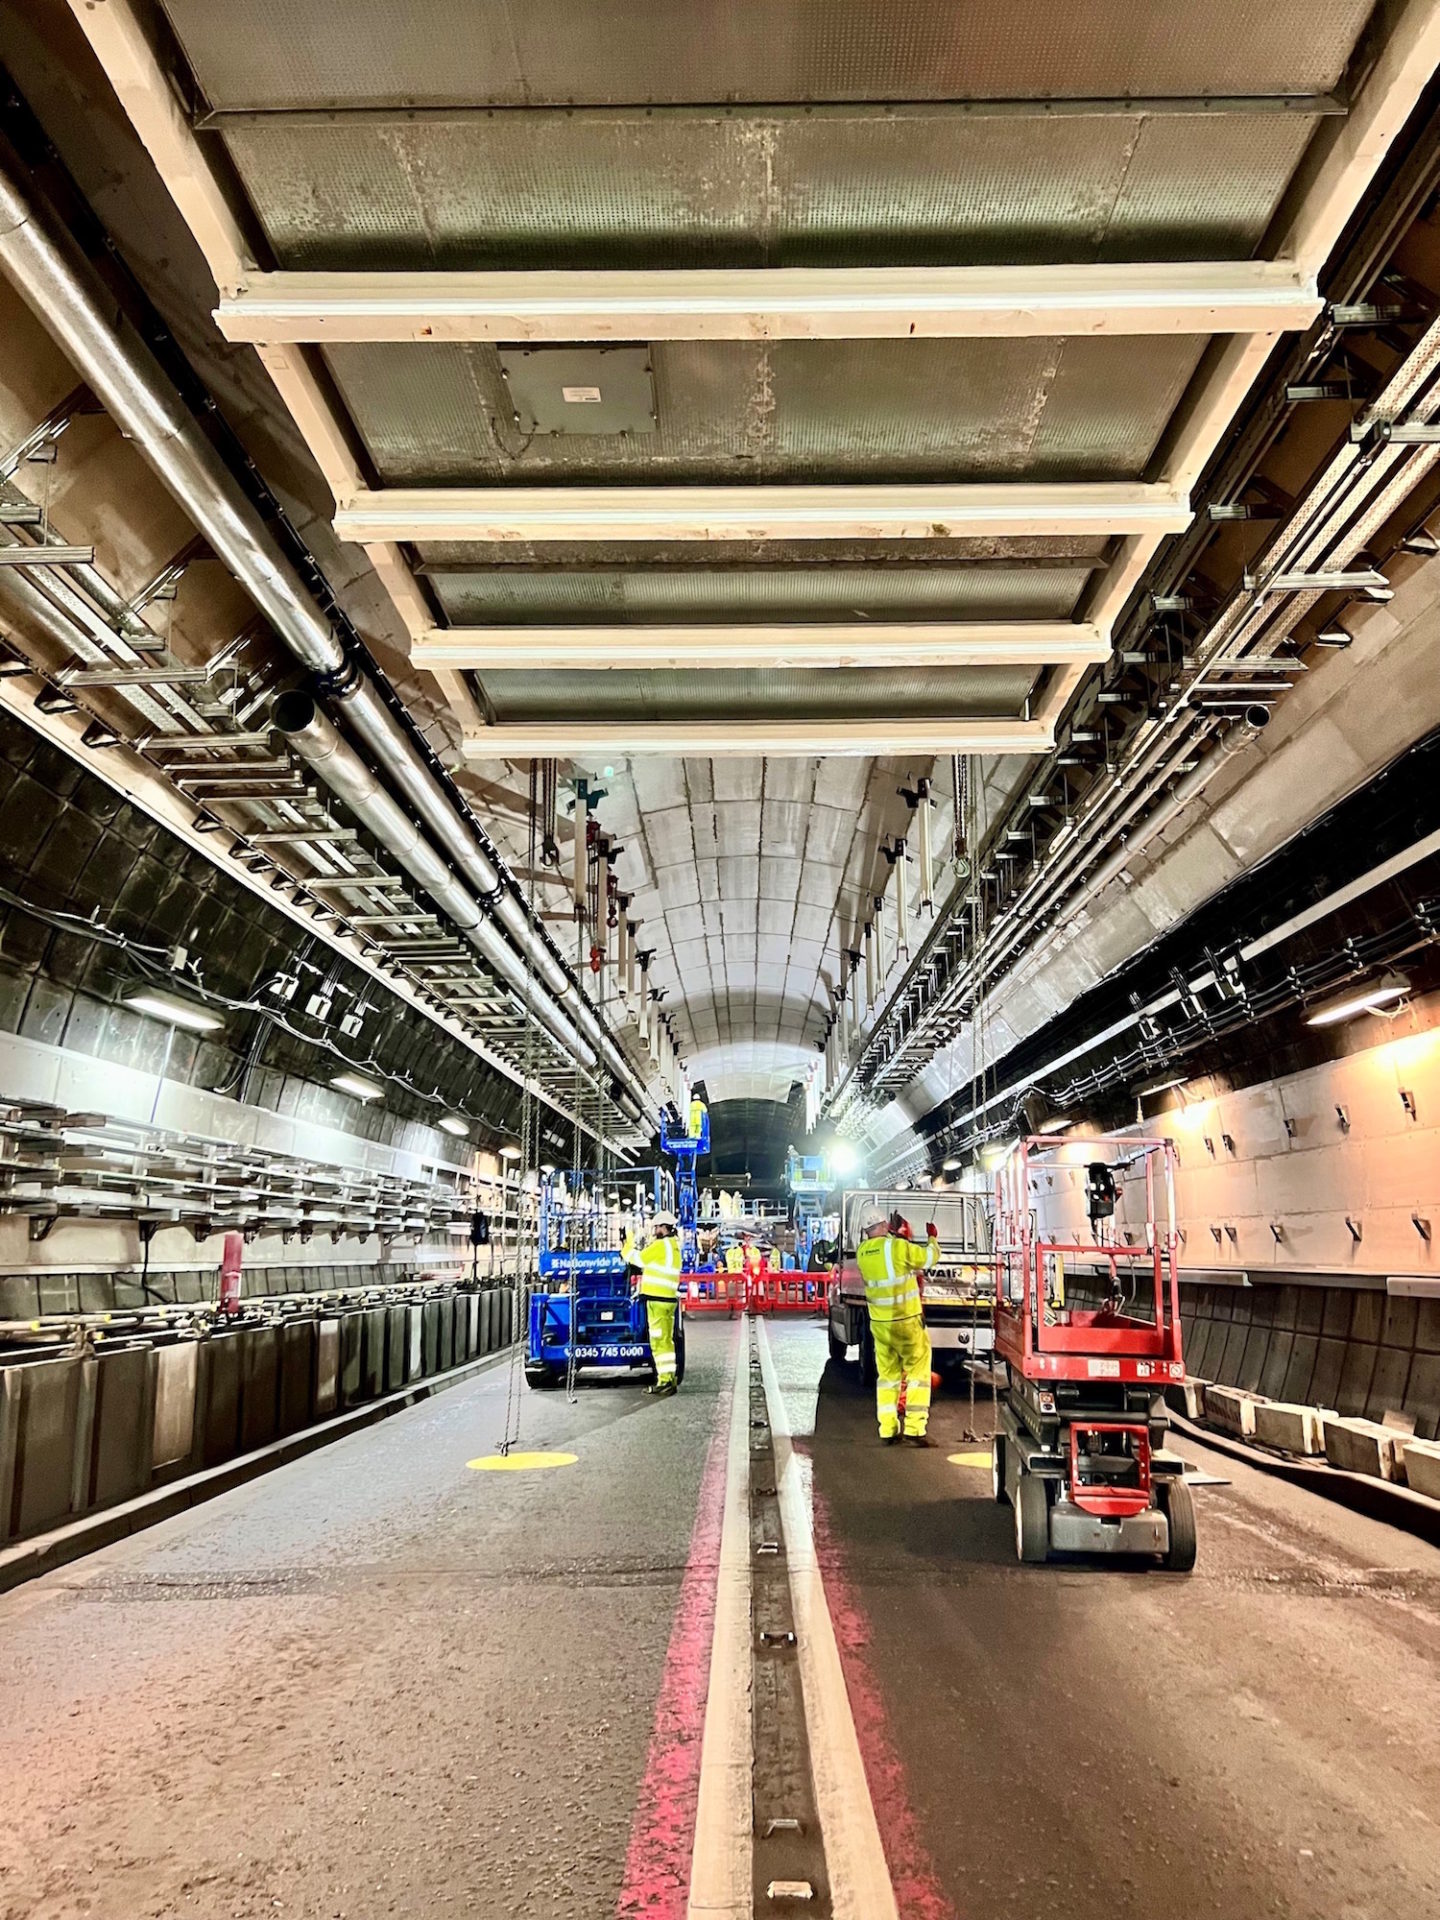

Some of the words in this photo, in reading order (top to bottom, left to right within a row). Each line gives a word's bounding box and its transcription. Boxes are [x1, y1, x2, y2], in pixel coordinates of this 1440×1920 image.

[560, 1257, 611, 1268] Nationwide
[575, 1347, 599, 1358] 0345
[600, 1347, 618, 1358] 745
[620, 1346, 644, 1357] 0000
